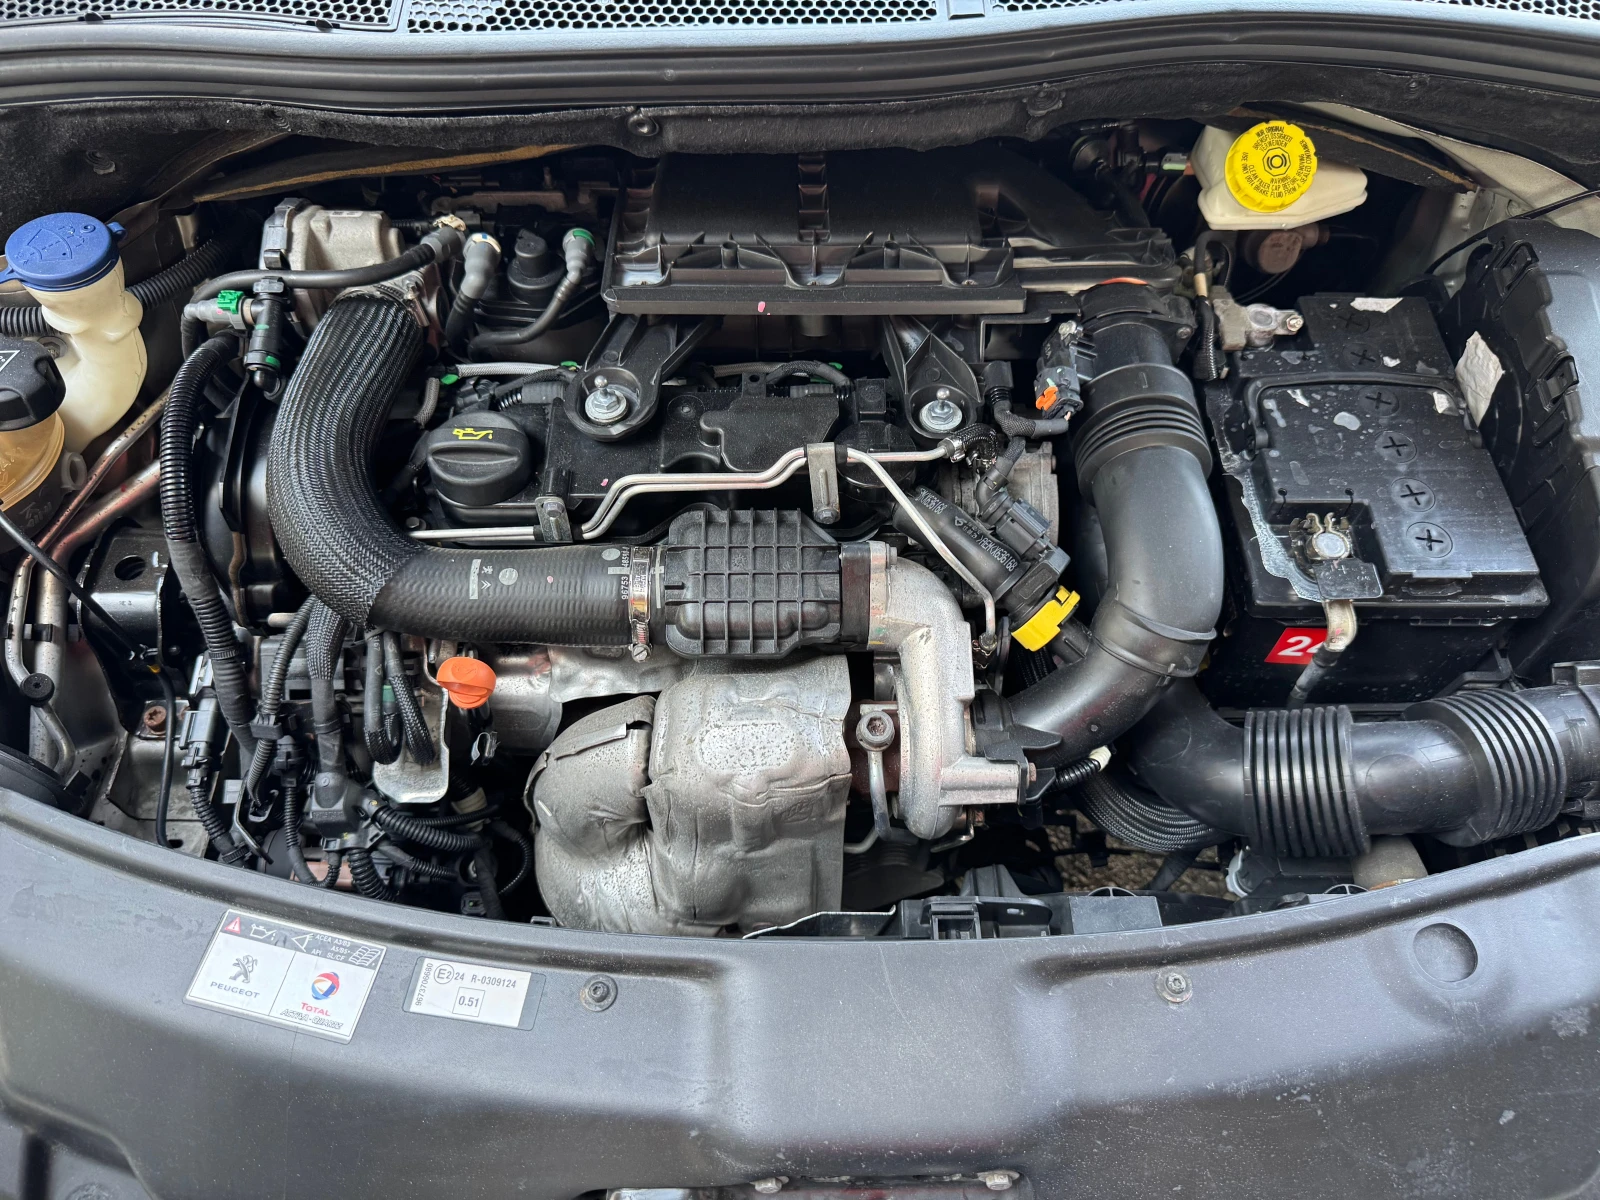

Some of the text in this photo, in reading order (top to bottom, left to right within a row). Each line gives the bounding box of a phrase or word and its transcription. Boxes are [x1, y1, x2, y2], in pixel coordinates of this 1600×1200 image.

[1249, 165, 1258, 179] CLEAN
[1258, 178, 1270, 190] FILLER
[1300, 166, 1311, 184] SEALED
[315, 934, 351, 947] ACEA A3/B3
[415, 963, 433, 1006] 9673706680
[454, 972, 465, 981] 24
[471, 975, 516, 988] R-0309124
[210, 981, 260, 998] PEUGEOT
[458, 996, 479, 1007] 0.51
